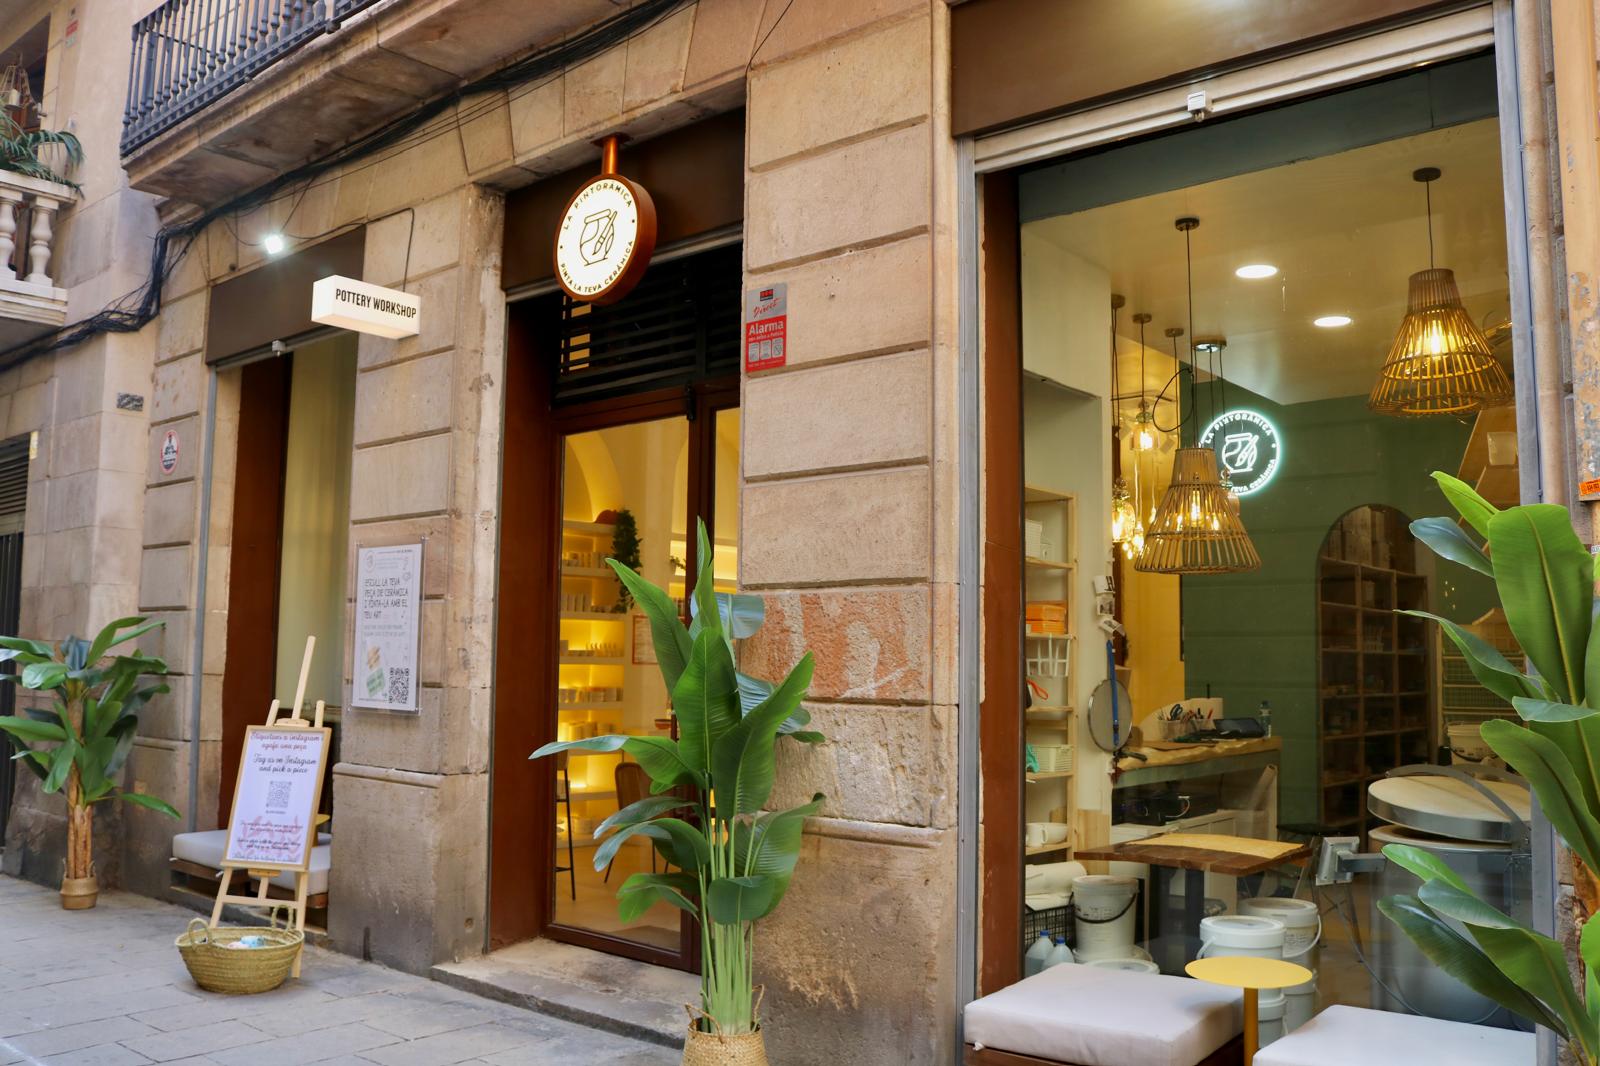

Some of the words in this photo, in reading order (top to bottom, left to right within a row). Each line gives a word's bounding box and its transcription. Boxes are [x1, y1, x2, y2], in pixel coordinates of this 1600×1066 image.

[563, 215, 573, 230] LA
[561, 263, 573, 285] PINTA
[584, 284, 602, 293] TEVA
[335, 288, 371, 308] POTTERY
[373, 297, 417, 319] WORKSHOP
[749, 320, 784, 336] Alarma
[1204, 432, 1215, 444] LA
[253, 753, 266, 764] Tag
[292, 766, 308, 774] piece
